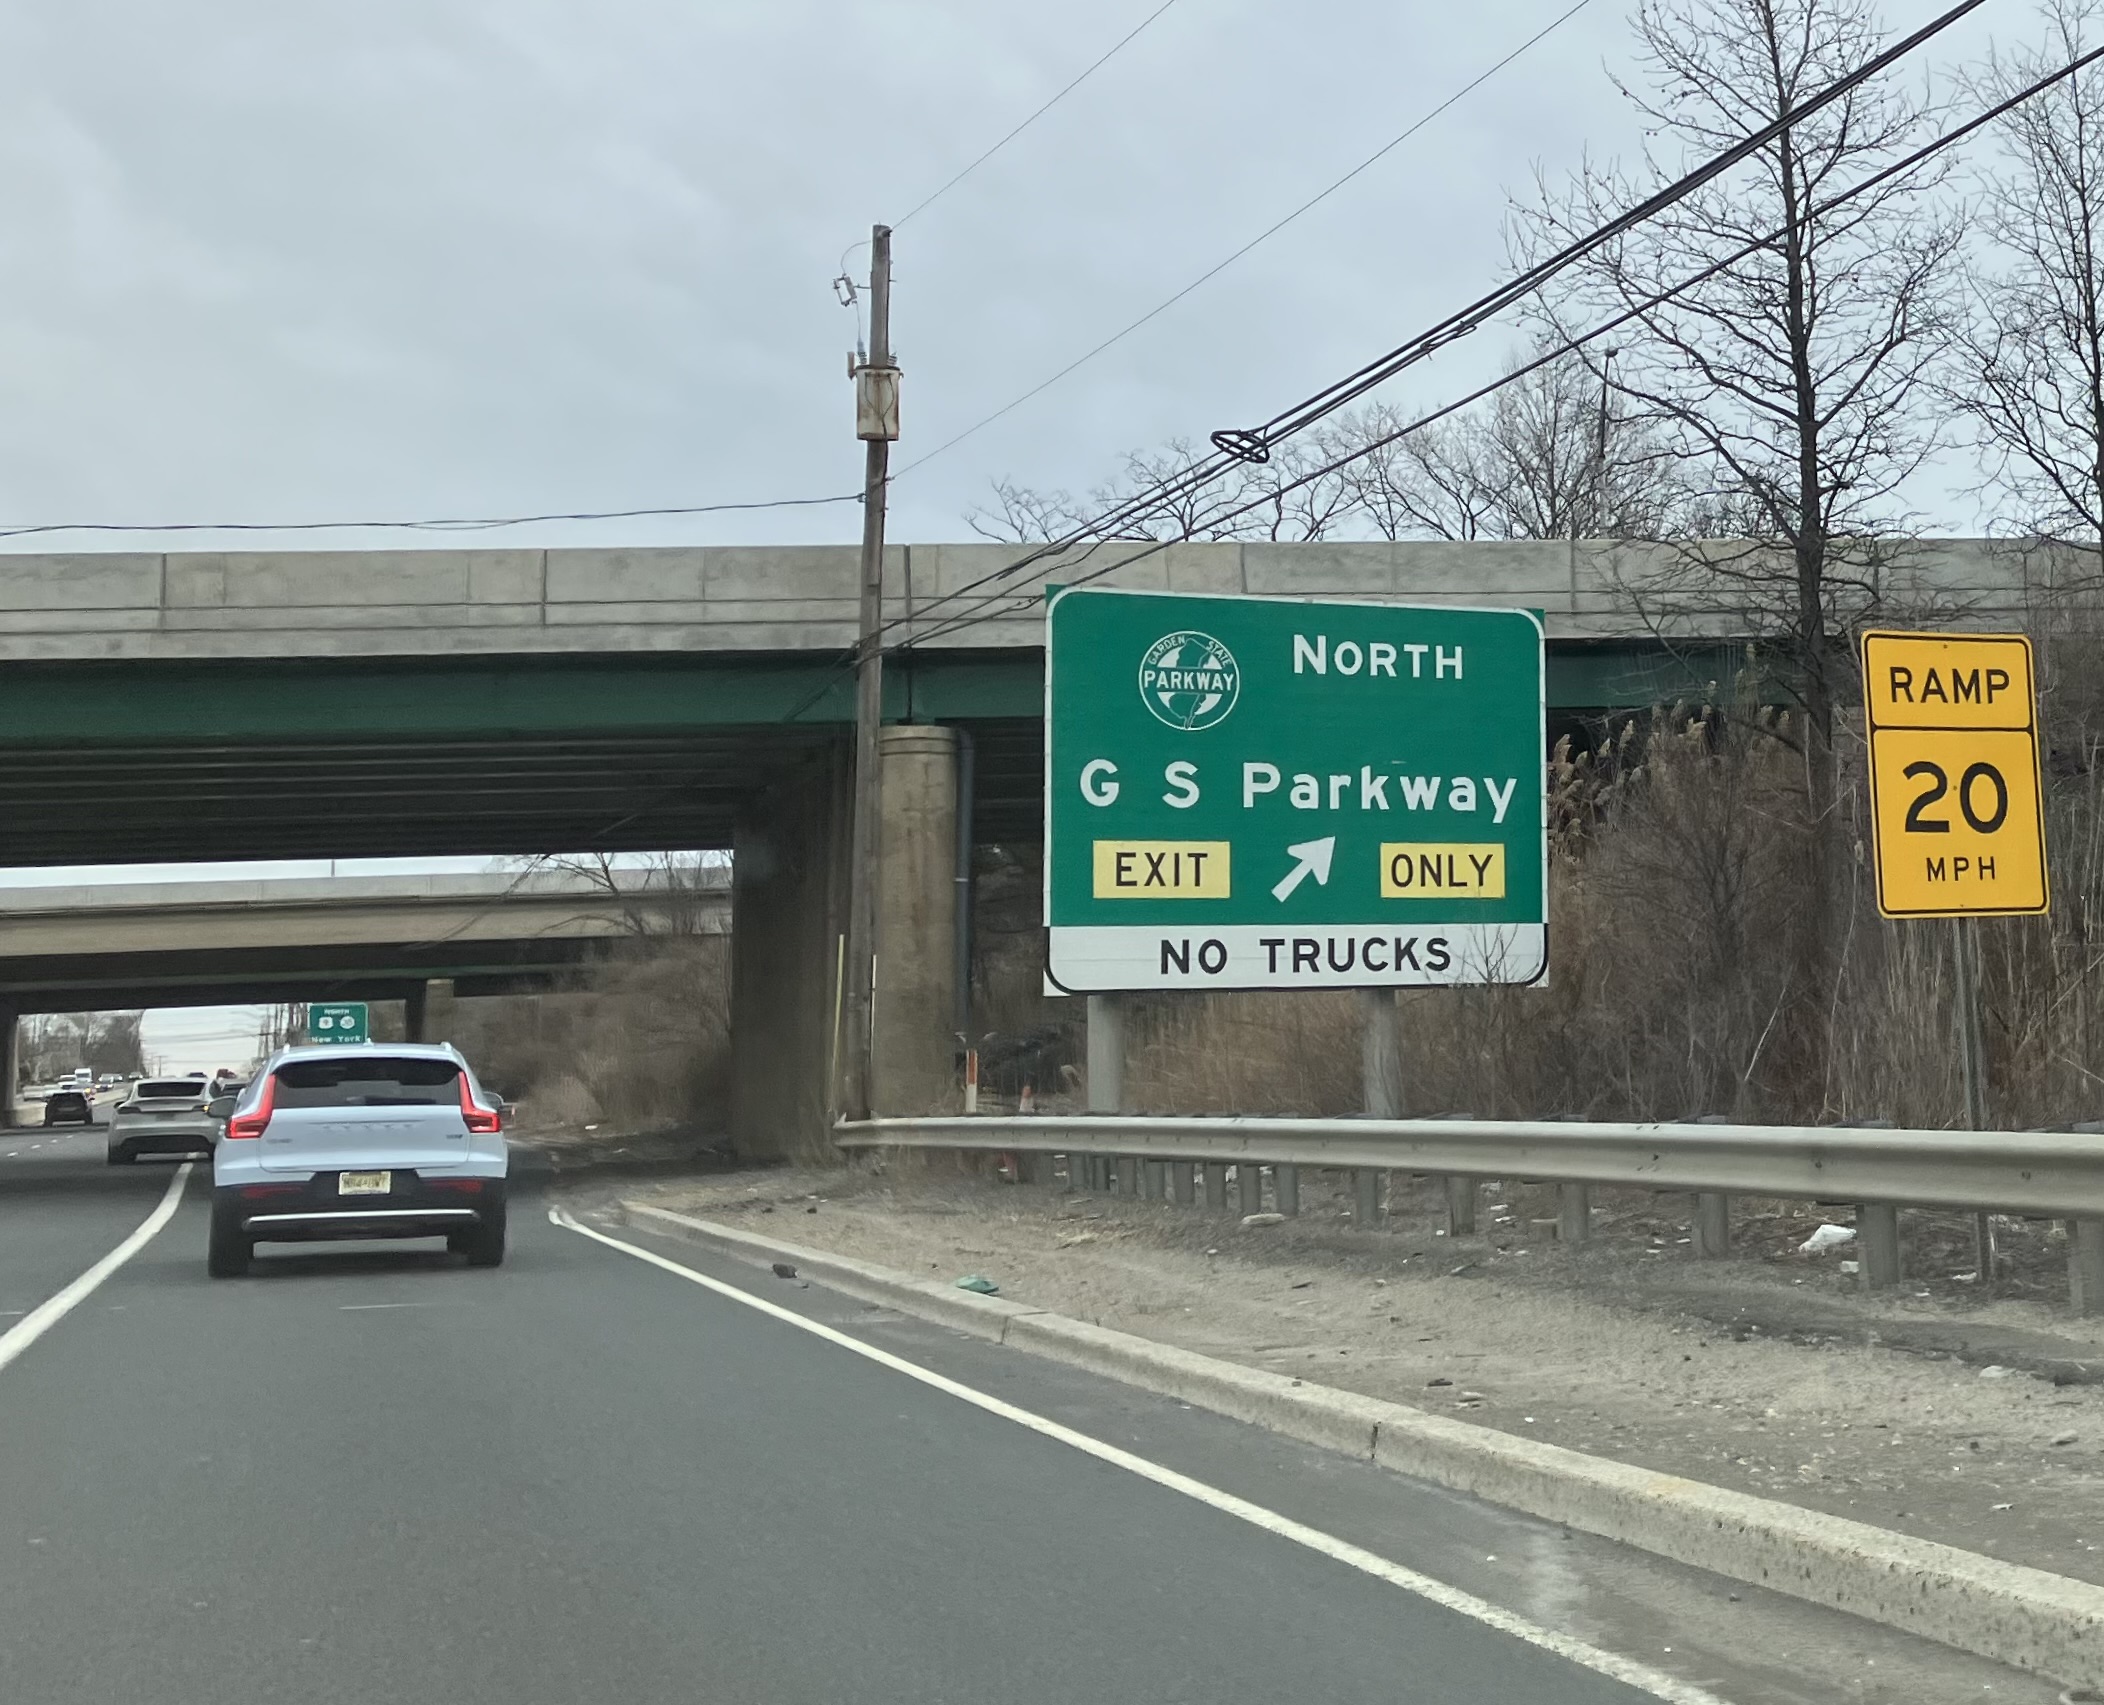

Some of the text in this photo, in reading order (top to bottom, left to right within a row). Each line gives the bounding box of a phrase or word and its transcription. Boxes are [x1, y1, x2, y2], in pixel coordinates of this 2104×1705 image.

[1148, 635, 1232, 667] GARDEN STATE
[1293, 634, 1464, 680] NORTH
[1144, 670, 1235, 691] PARKWAY
[1890, 666, 2010, 704] RAMP
[1080, 758, 1518, 824] G S Parkway
[1902, 760, 2008, 834] 20
[1115, 851, 1494, 888] EXIT ONLY
[1926, 856, 1996, 882] MPH
[1160, 936, 1451, 975] NO TRUCKS
[337, 1035, 361, 1043] York
